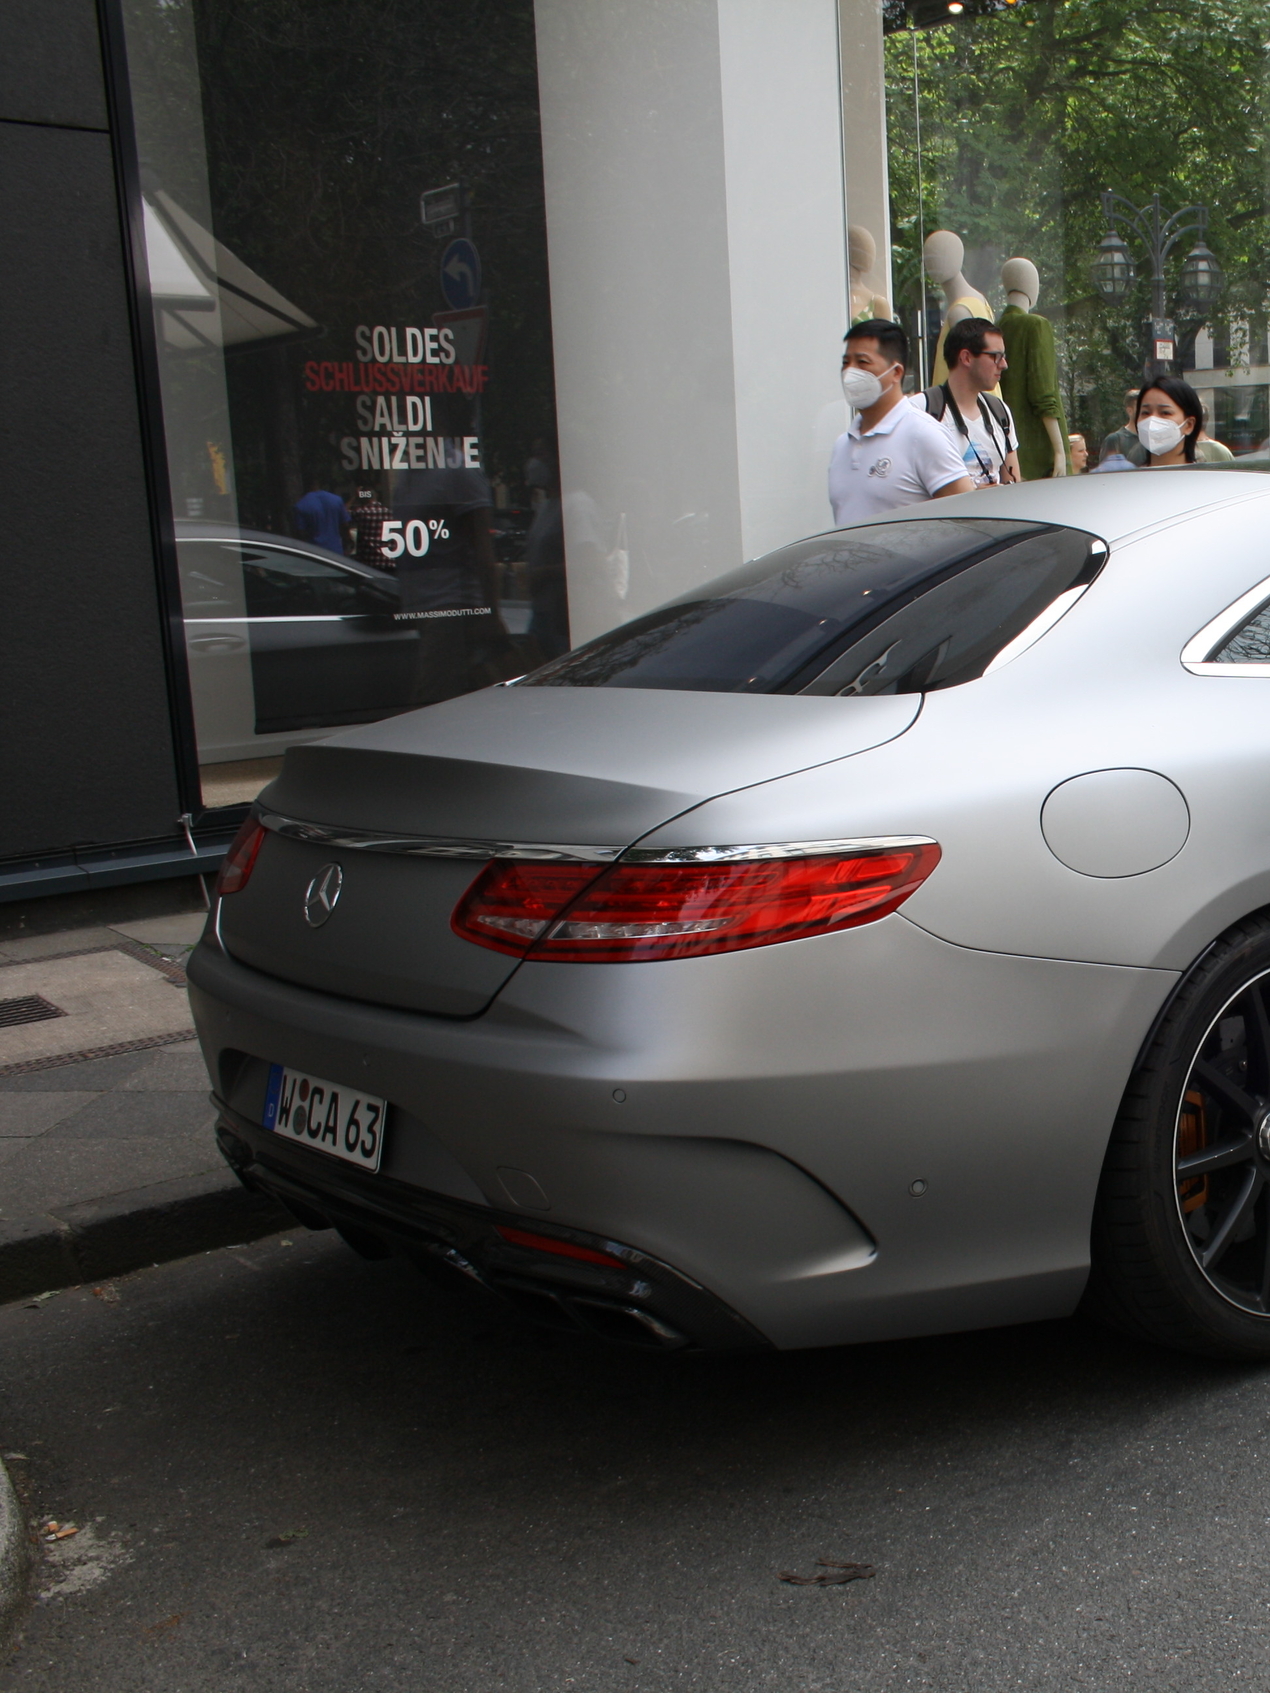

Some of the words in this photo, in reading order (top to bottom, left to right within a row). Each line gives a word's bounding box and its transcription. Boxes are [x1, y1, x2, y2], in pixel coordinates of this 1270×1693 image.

[355, 325, 456, 364] SOLDES
[305, 362, 489, 393] SCHLUSSVERKAUF
[356, 395, 433, 431] SALDI
[340, 431, 481, 470] SNIŽENJE
[358, 490, 372, 498] BIS
[381, 519, 450, 558] 50%
[393, 607, 491, 620] WWW.MASSIMODUTTI.COM
[345, 1099, 380, 1158] 63
